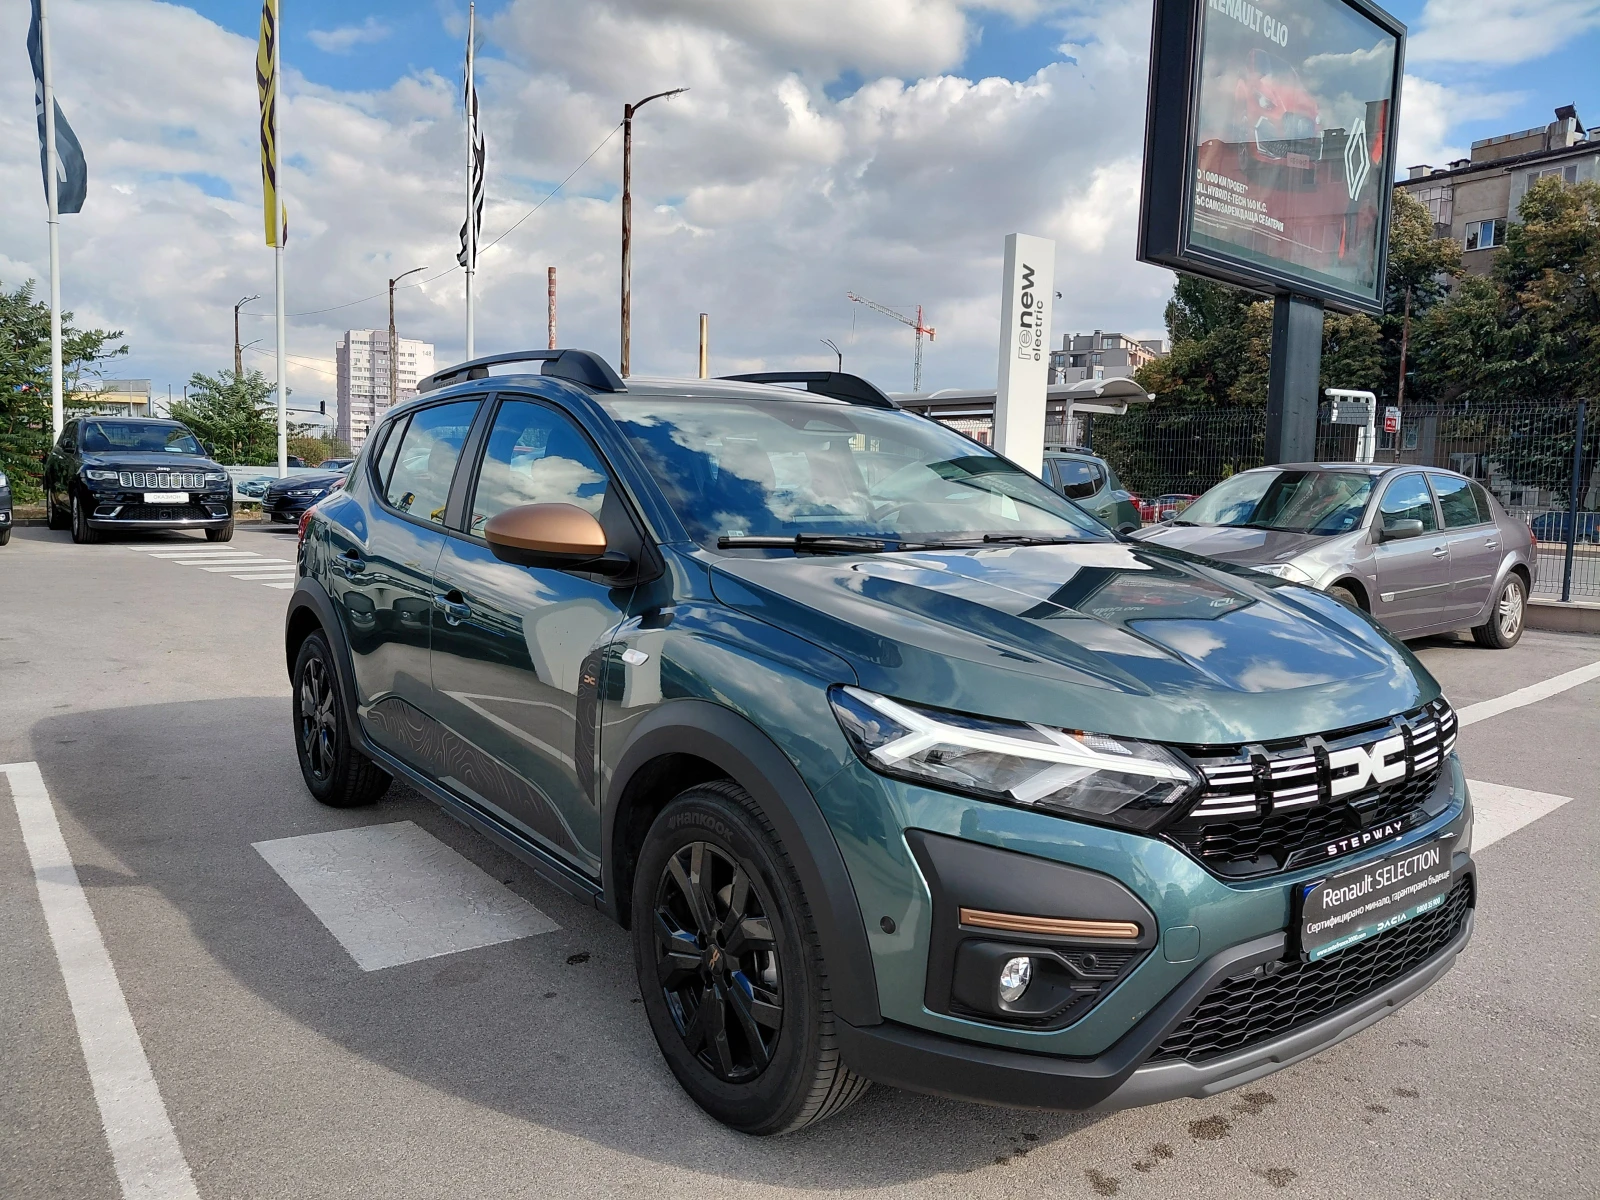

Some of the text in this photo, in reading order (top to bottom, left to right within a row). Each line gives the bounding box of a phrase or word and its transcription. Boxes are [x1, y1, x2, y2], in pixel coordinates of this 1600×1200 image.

[1263, 15, 1289, 47] CLIO
[1195, 182, 1208, 194] ULL
[1207, 185, 1228, 201] HYBRID
[1227, 193, 1247, 207] E-TECH
[1018, 263, 1035, 360] renew
[1032, 300, 1044, 362] electric
[1327, 821, 1402, 856] STEPWAY
[1306, 870, 1450, 934] Сертифицирано минало, гарантирано бъдеще
[1322, 847, 1440, 909] Renault SELECTION
[1377, 913, 1407, 931] DACIA
